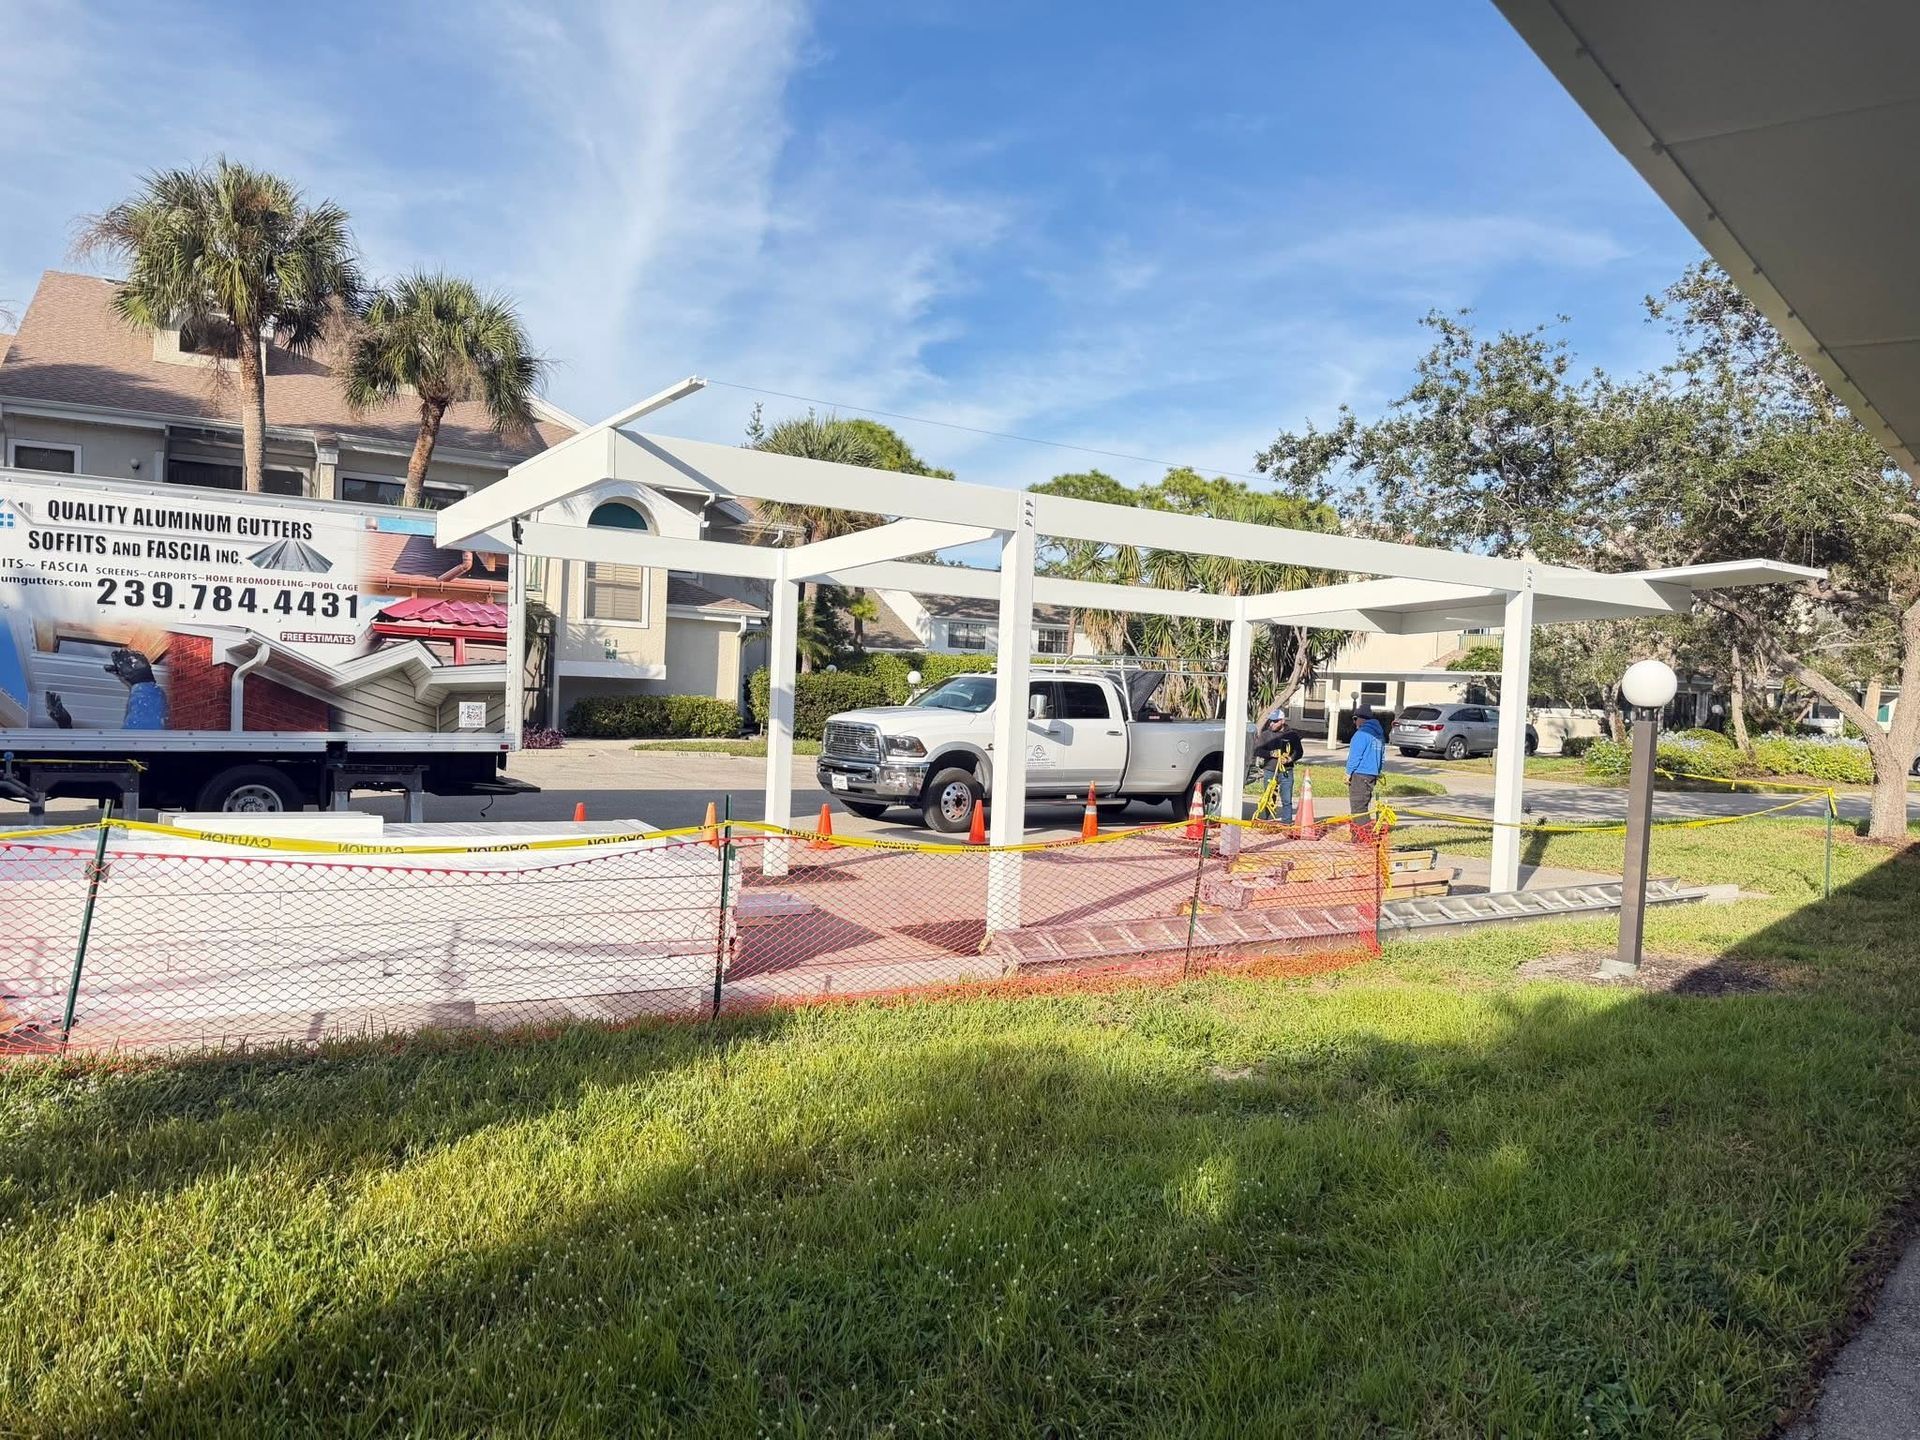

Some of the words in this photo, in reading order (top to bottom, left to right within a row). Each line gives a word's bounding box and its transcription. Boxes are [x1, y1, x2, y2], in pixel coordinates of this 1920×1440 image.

[48, 500, 127, 524] QUALITY
[133, 507, 231, 533] ALUMINUM
[237, 517, 312, 540] GUTTERS
[29, 530, 106, 555] SOFFITS
[112, 541, 141, 557] AND
[147, 540, 210, 562] FASCIA
[216, 550, 242, 565] INC.
[41, 561, 88, 573] FASCIA
[97, 578, 358, 619] 239.784.4431
[337, 583, 359, 592] CAGE
[281, 632, 304, 642] FREE
[305, 633, 355, 644] ESTIMATES
